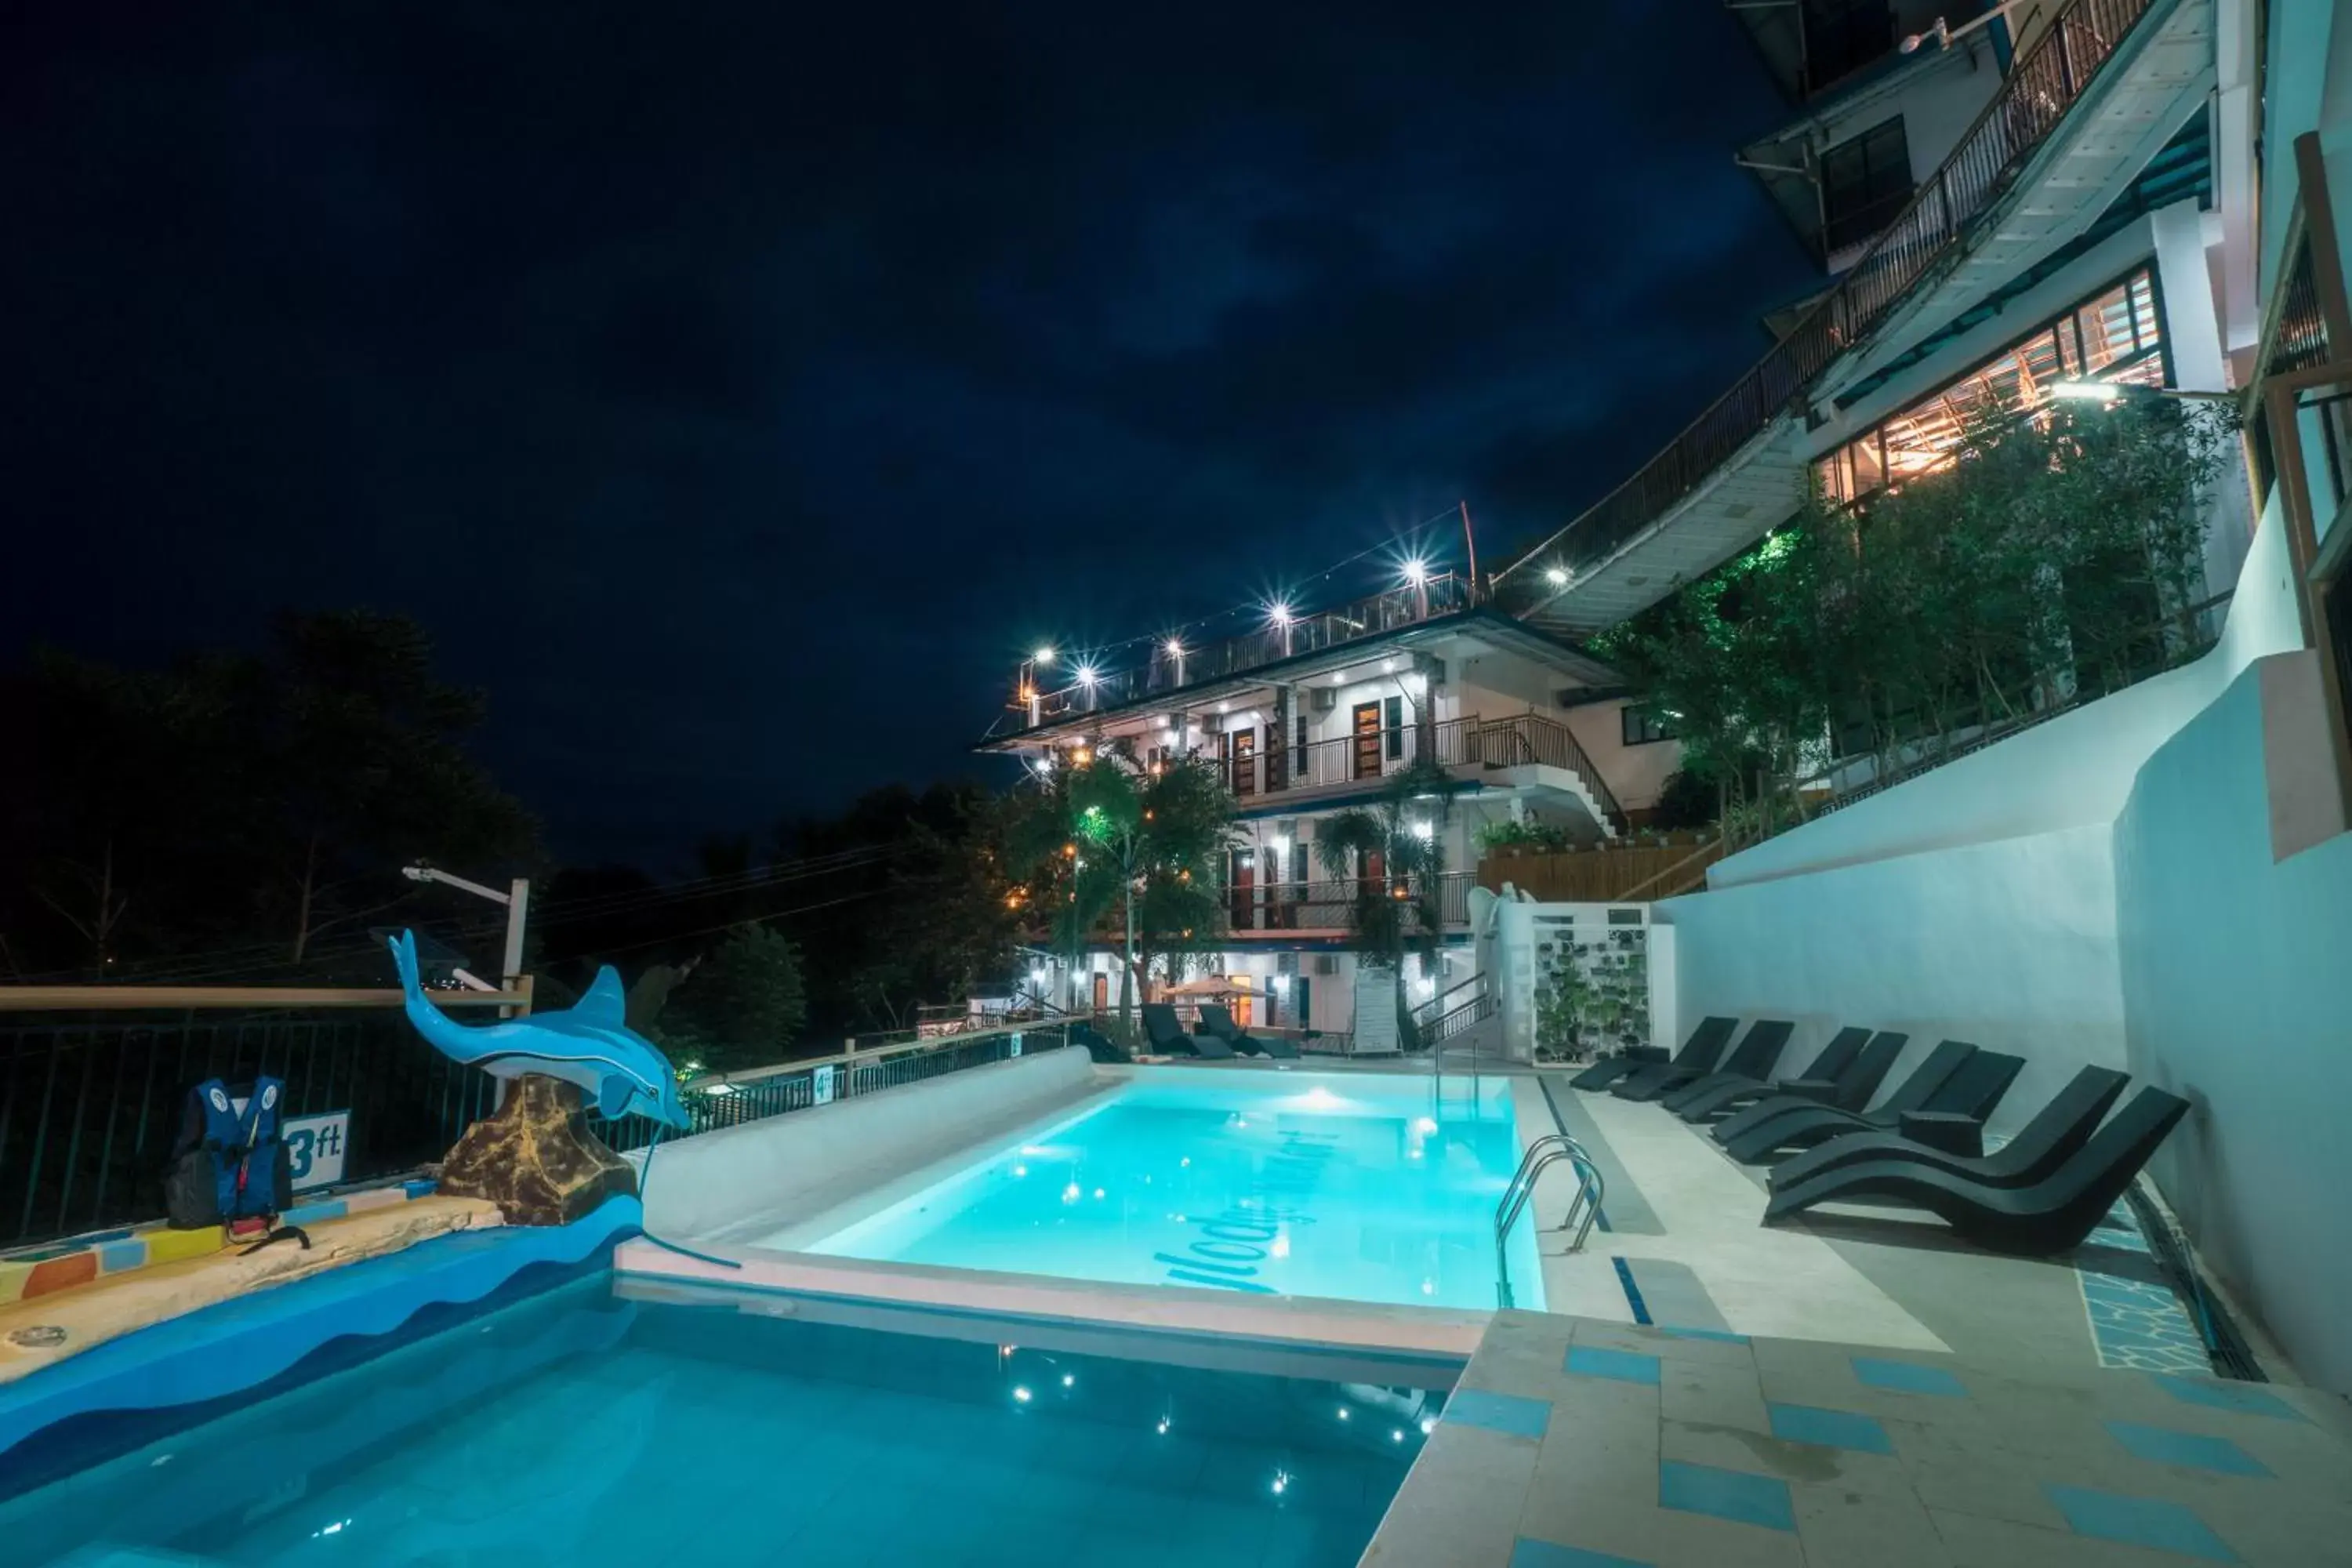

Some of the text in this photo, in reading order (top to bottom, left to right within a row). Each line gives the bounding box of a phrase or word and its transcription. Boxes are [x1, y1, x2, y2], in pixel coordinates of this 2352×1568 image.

[817, 1073, 823, 1098] 4
[287, 1123, 340, 1179] 3 ft.
